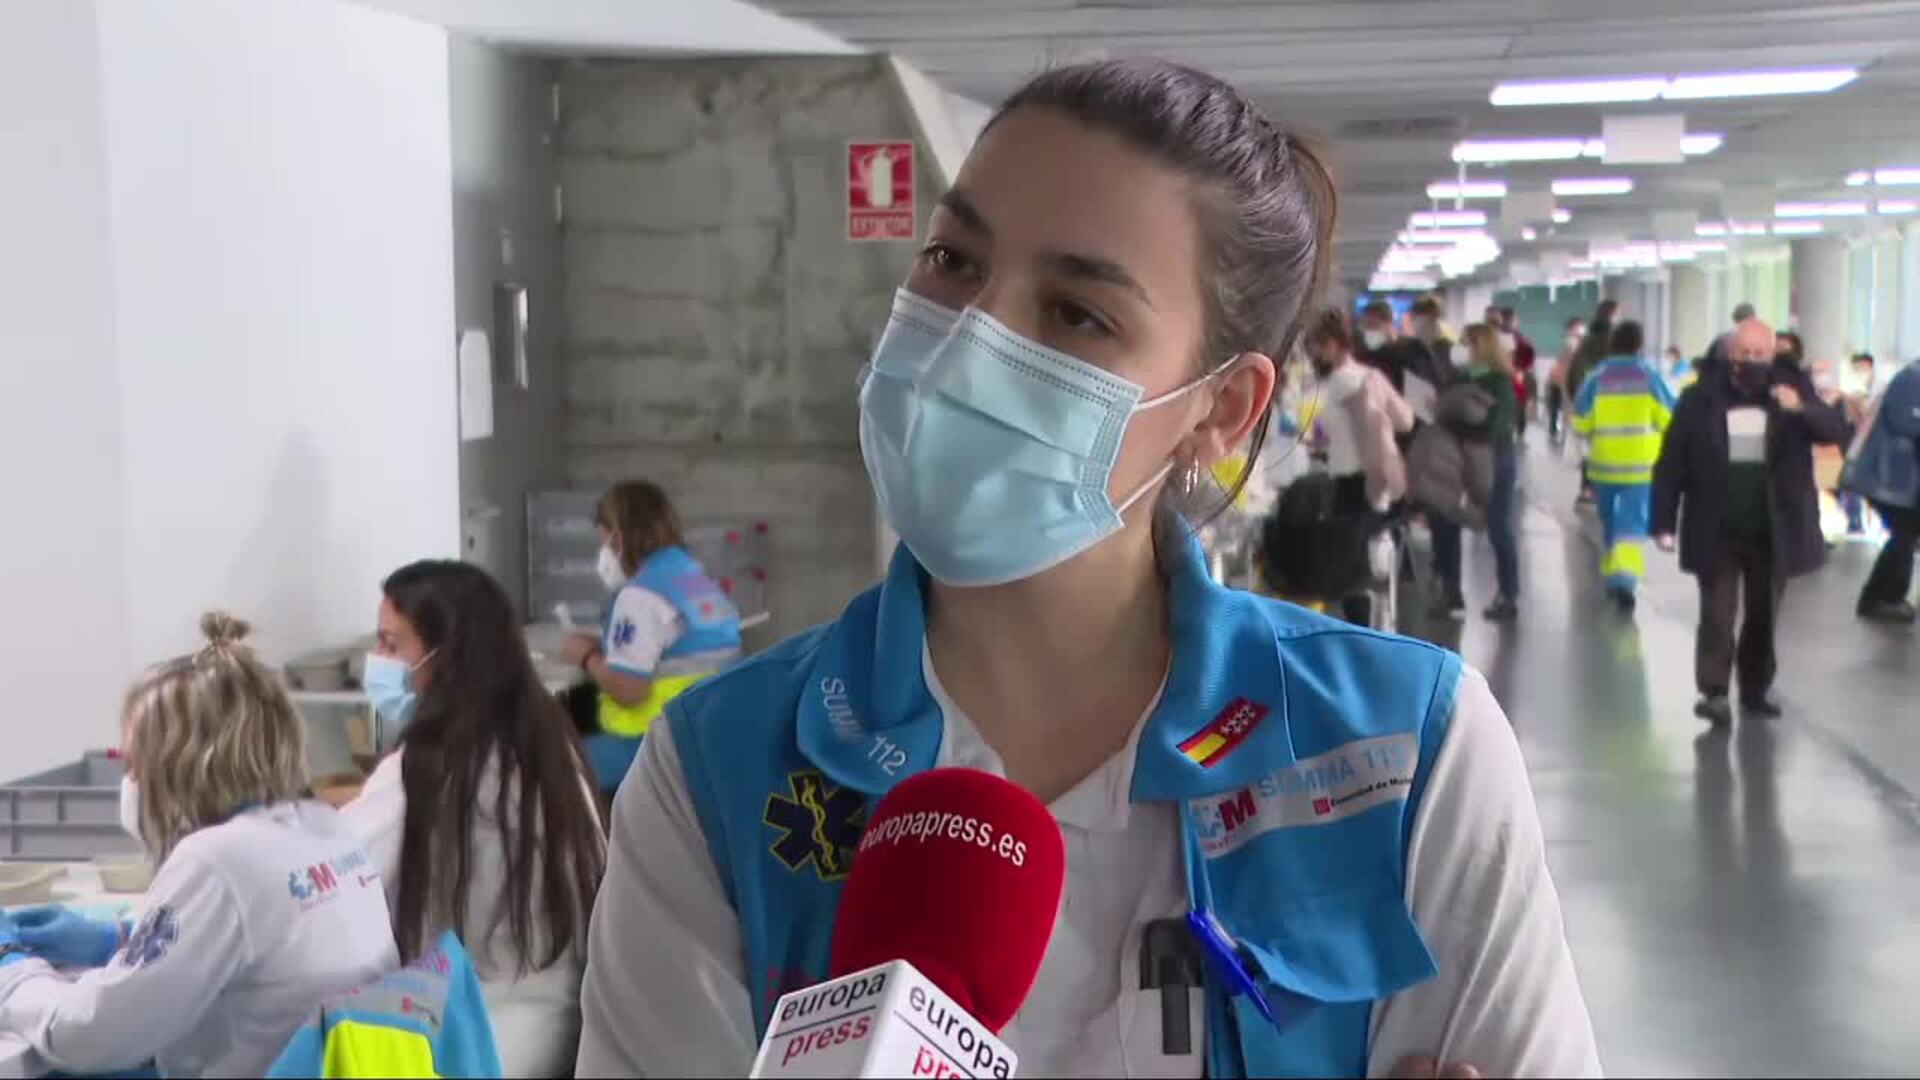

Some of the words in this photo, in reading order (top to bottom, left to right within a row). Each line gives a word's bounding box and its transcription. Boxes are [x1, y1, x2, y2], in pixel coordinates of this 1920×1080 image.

[867, 736, 906, 776] 112
[1219, 789, 1257, 831] M
[859, 811, 1027, 867] europapress.es
[781, 972, 887, 1022] europa
[781, 1015, 872, 1067] press
[909, 986, 1010, 1079] europa
